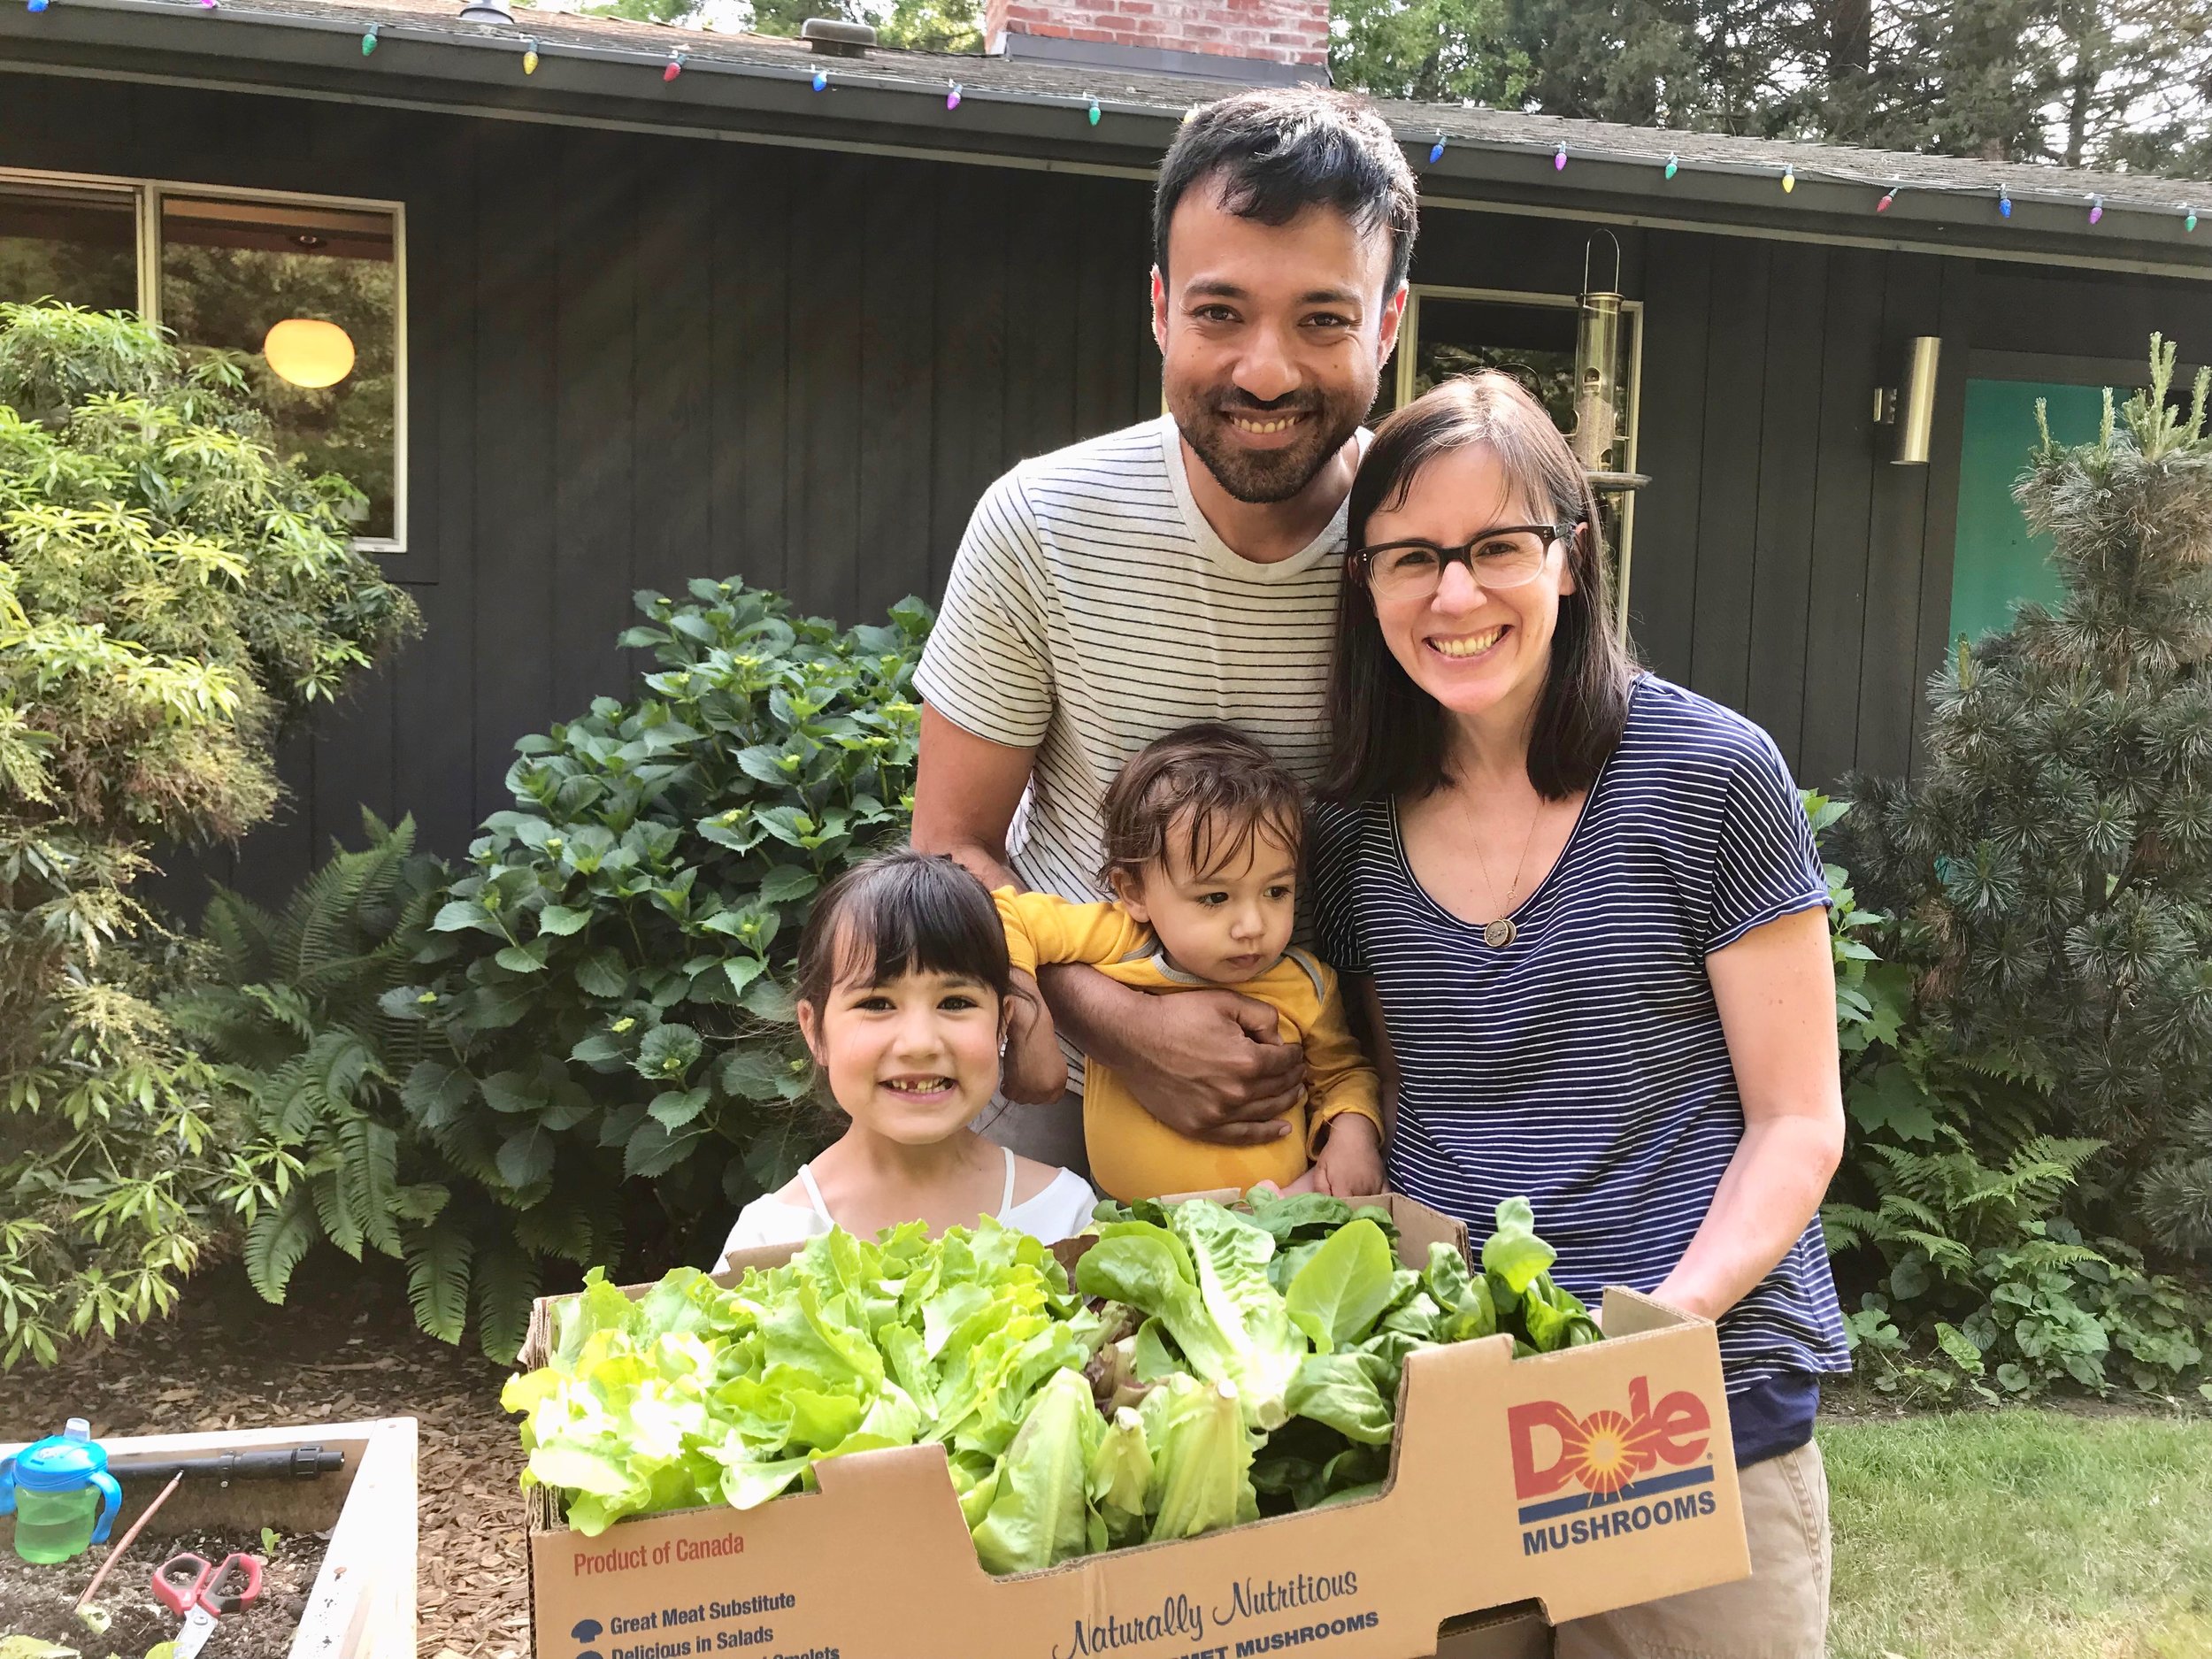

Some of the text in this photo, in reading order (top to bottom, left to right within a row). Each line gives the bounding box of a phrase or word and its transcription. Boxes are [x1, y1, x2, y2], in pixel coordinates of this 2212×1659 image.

[1508, 1376, 1711, 1501] Dole
[1523, 1490, 1717, 1556] MUSHROOMS
[573, 1532, 744, 1576] Product of Canada
[611, 1592, 795, 1635] Great Meat Substitute
[1052, 1571, 1358, 1659] Naturally Nutritious
[1235, 1611, 1379, 1659] MUSHROOMS
[696, 1635, 711, 1654] in
[717, 1625, 773, 1650] Salads
